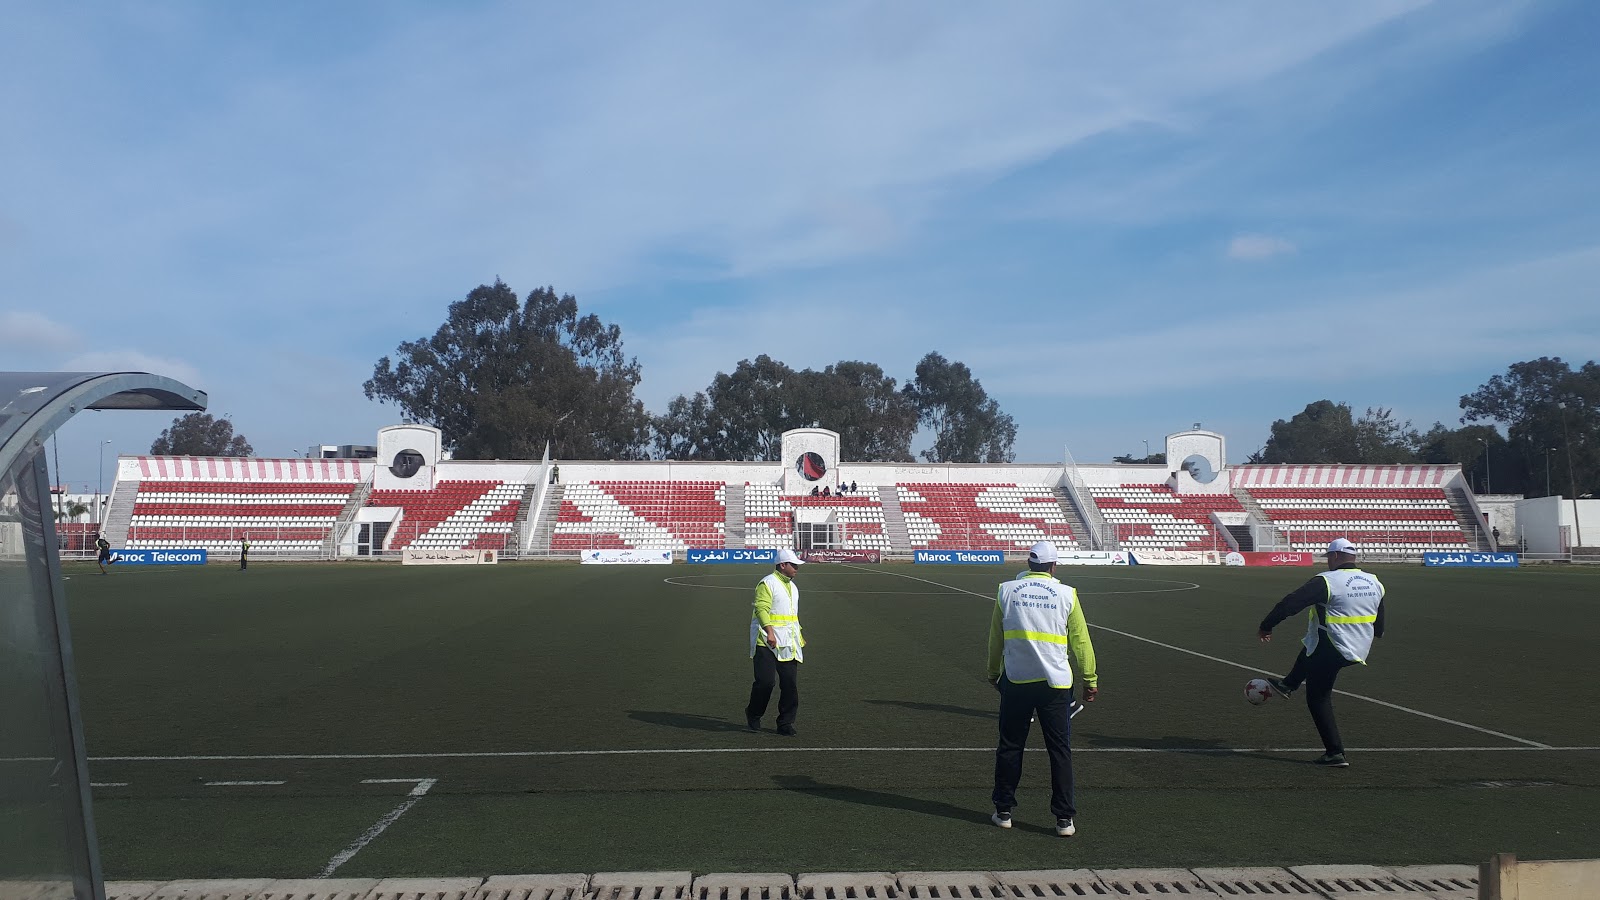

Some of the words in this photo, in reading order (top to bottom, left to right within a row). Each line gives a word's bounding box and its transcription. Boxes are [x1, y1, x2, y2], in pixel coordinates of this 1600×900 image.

[151, 552, 202, 562] Telecom
[691, 550, 729, 562] المغرب
[733, 551, 773, 560] اتصالات
[918, 552, 952, 562] Maroc
[956, 552, 1000, 562] Telecom
[1428, 554, 1467, 564] المغرب
[1472, 554, 1514, 563] اتصالات
[1029, 581, 1058, 597] AMBULANCE
